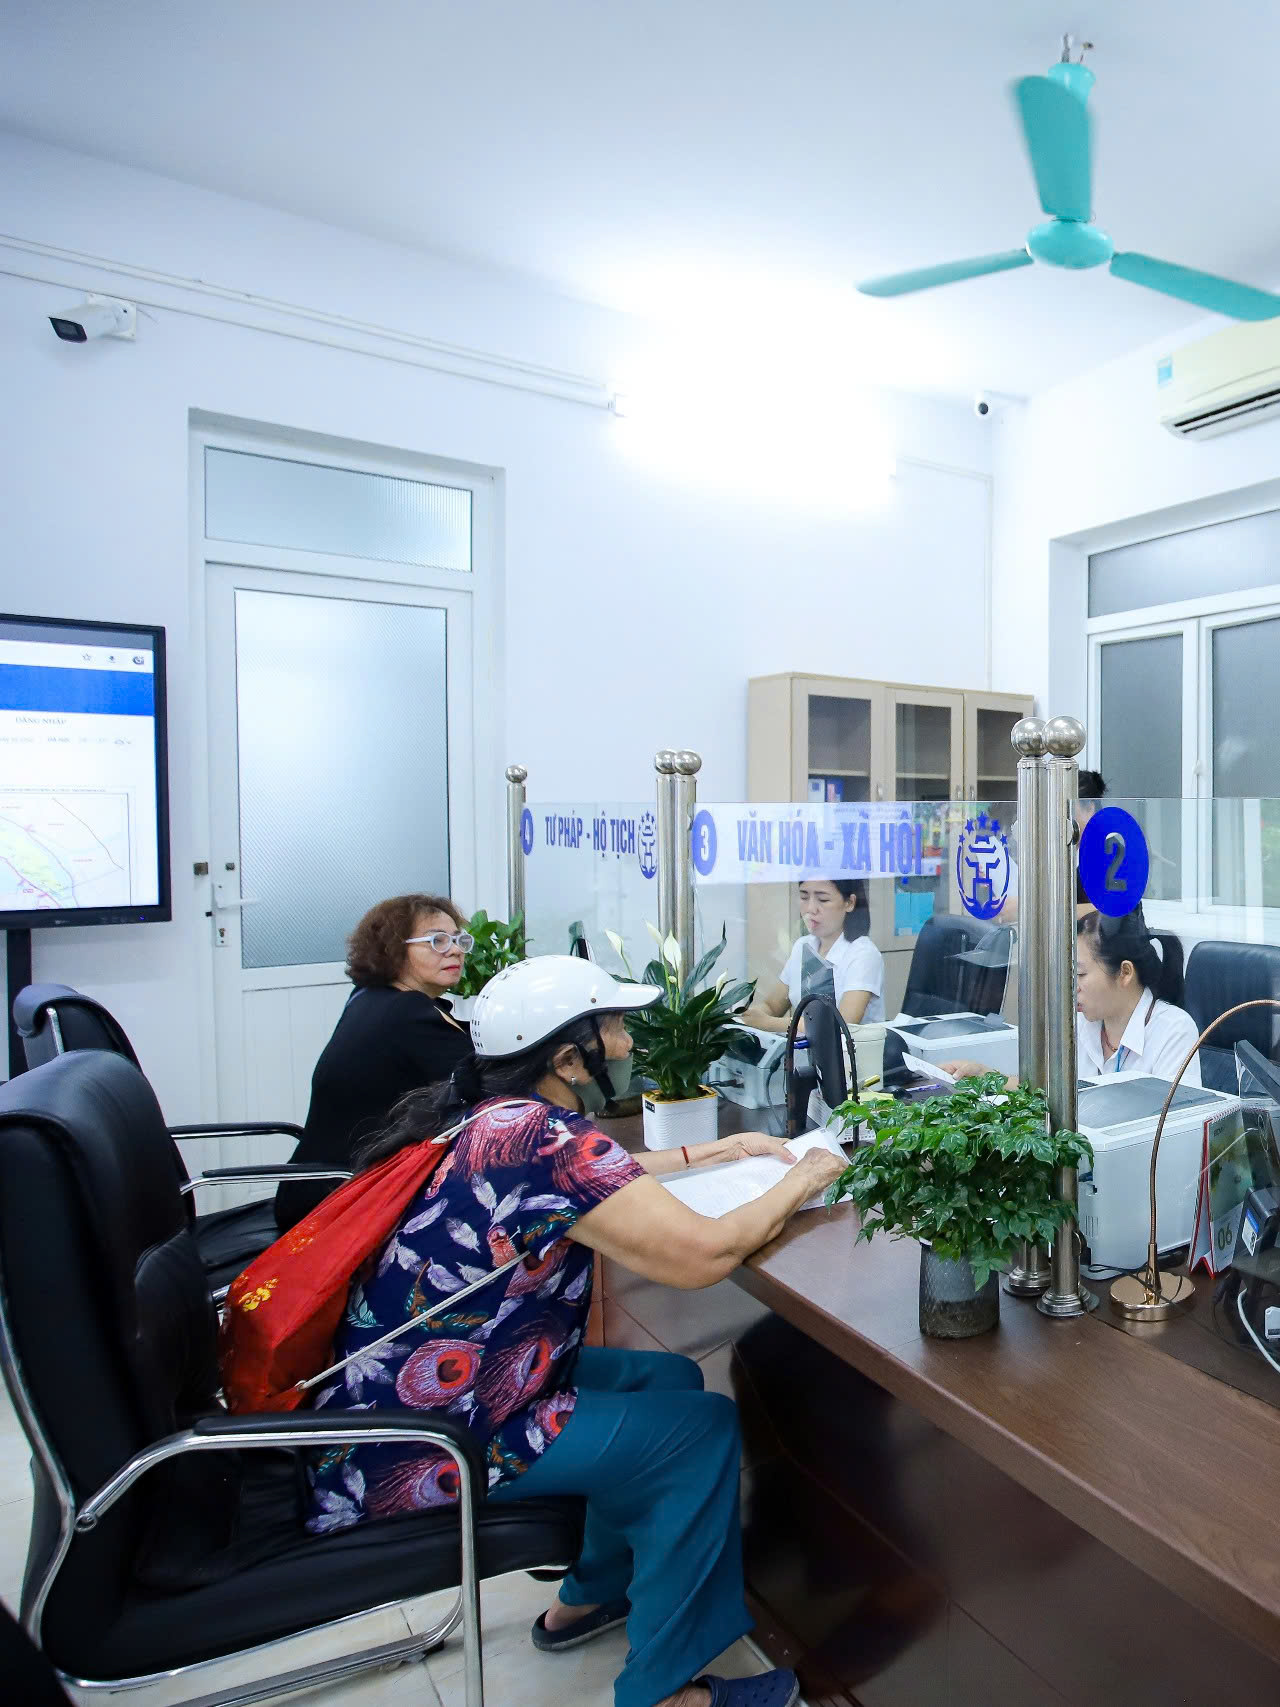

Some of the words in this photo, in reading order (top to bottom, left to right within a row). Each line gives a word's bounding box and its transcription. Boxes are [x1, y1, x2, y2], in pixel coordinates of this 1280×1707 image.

[545, 814, 558, 846] TƯ
[558, 810, 583, 849] PHÁP
[593, 811, 607, 858] HỘ
[610, 818, 636, 859] TỊCH
[700, 824, 710, 862] 3
[737, 810, 772, 863] VĂN
[778, 809, 821, 867] HÓA
[879, 810, 923, 885] HỘI
[1104, 832, 1127, 892] 2
[1217, 1222, 1233, 1251] 06
